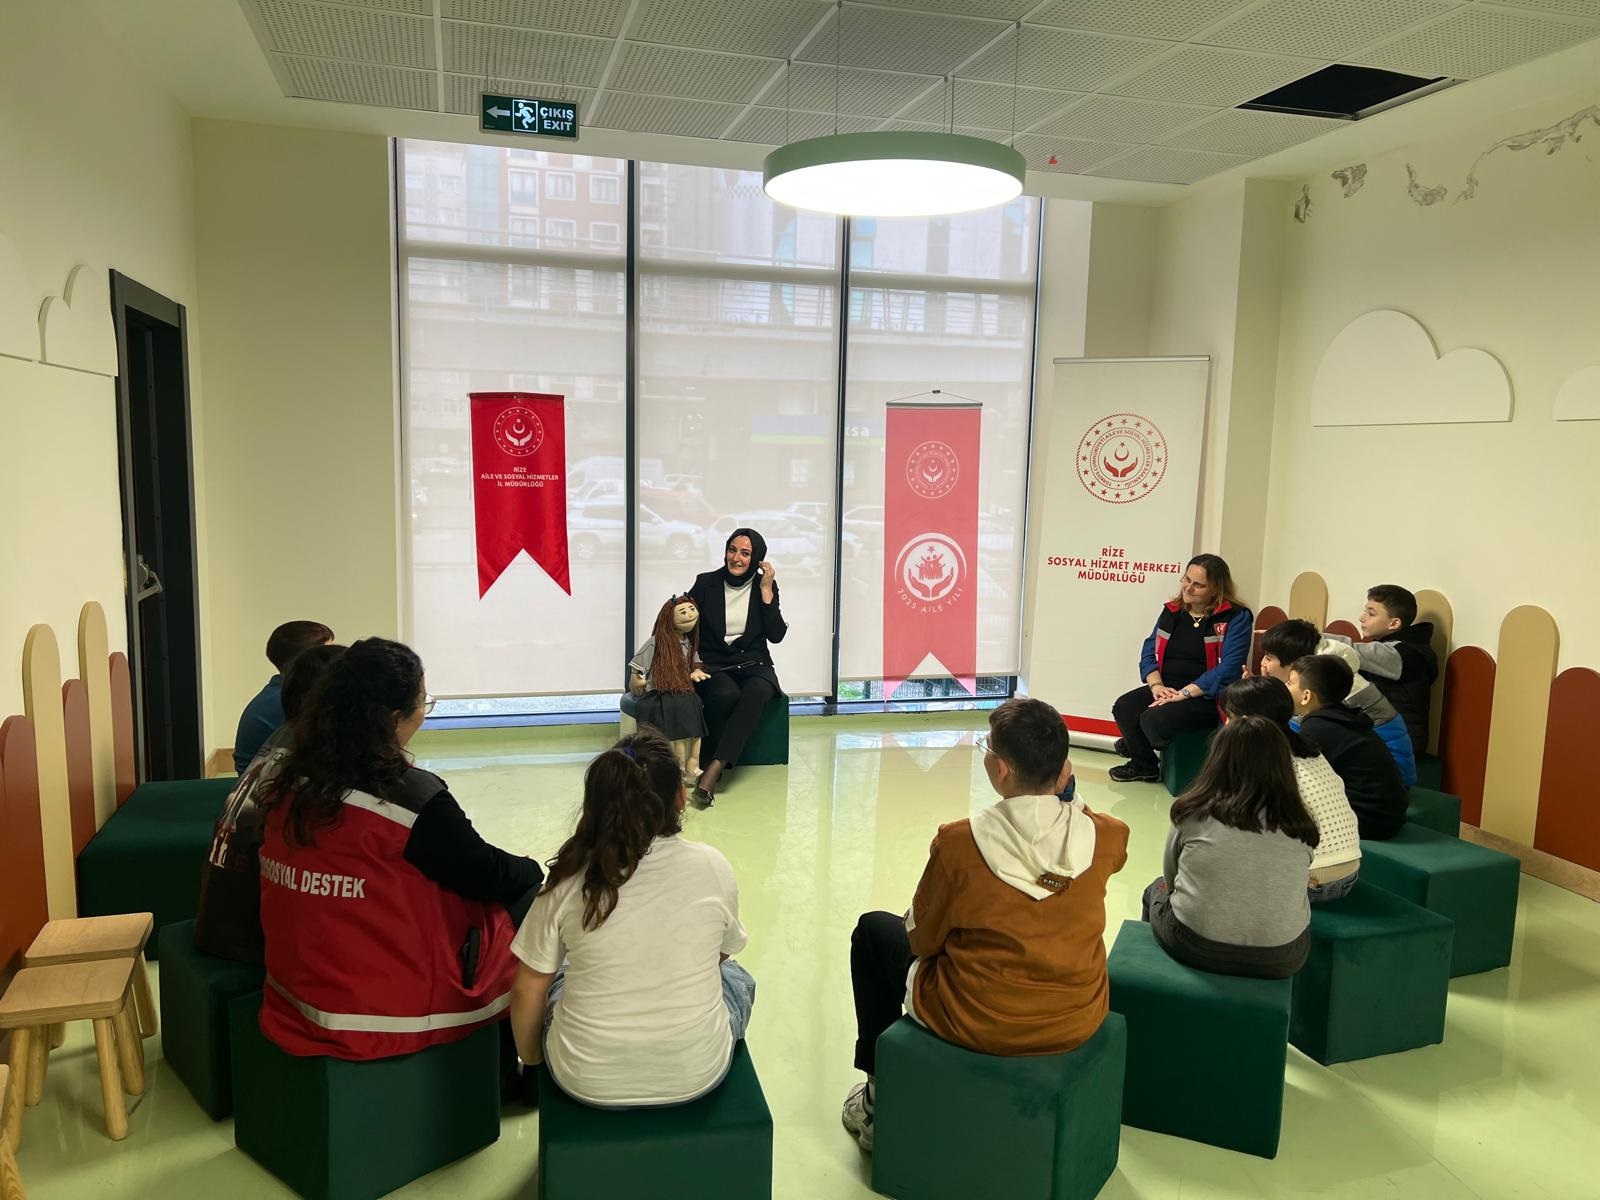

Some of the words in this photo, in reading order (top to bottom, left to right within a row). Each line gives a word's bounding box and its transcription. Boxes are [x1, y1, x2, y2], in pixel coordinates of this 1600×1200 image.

[540, 107, 574, 121] ÇIKIŞ
[543, 119, 573, 131] EXIT
[1101, 545, 1125, 557] RİZE
[1047, 556, 1087, 568] SOSYAL
[1090, 557, 1130, 570] HİZMET
[1133, 561, 1181, 574] MERKEZİ
[1077, 569, 1146, 584] MÜDÜRLÜĞÜ
[897, 588, 916, 609] 2025
[921, 604, 943, 613] AİLE
[946, 587, 963, 605] YILI
[300, 870, 366, 899] DESTEK
